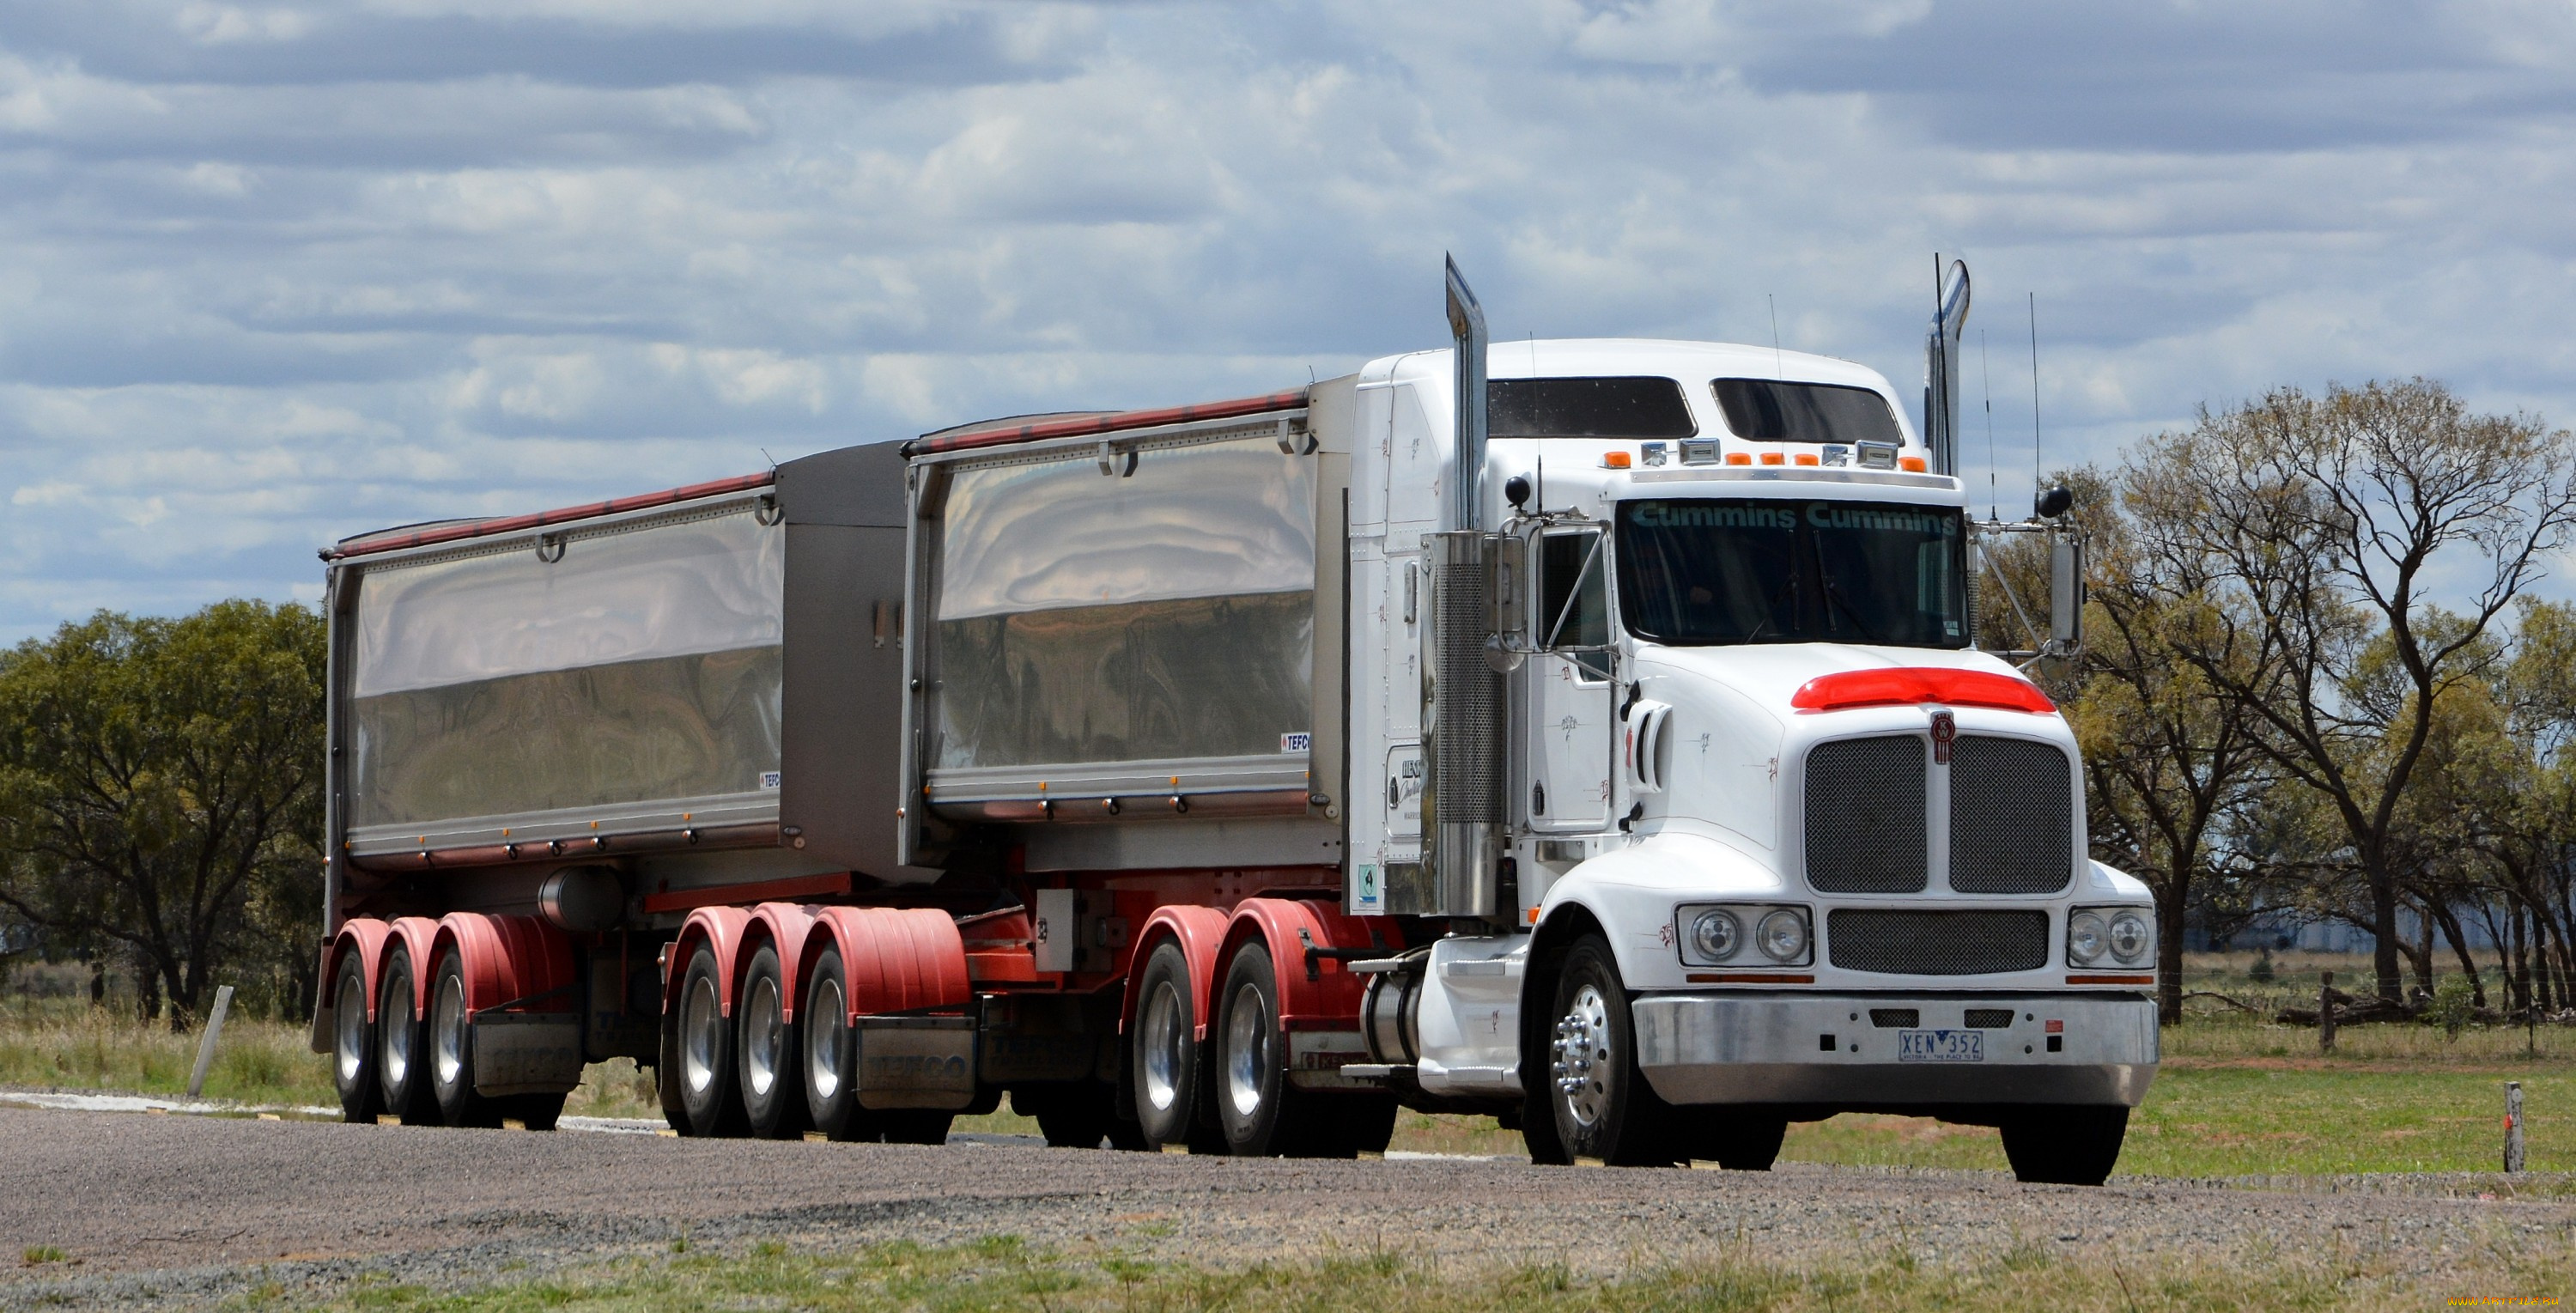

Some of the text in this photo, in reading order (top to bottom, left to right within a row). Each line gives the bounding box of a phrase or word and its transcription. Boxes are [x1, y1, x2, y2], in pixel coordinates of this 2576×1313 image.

[1632, 501, 1958, 536] Cummins Cummins
[1903, 1035, 1979, 1053] XEN 352
[867, 1055, 966, 1078] TEFCO
